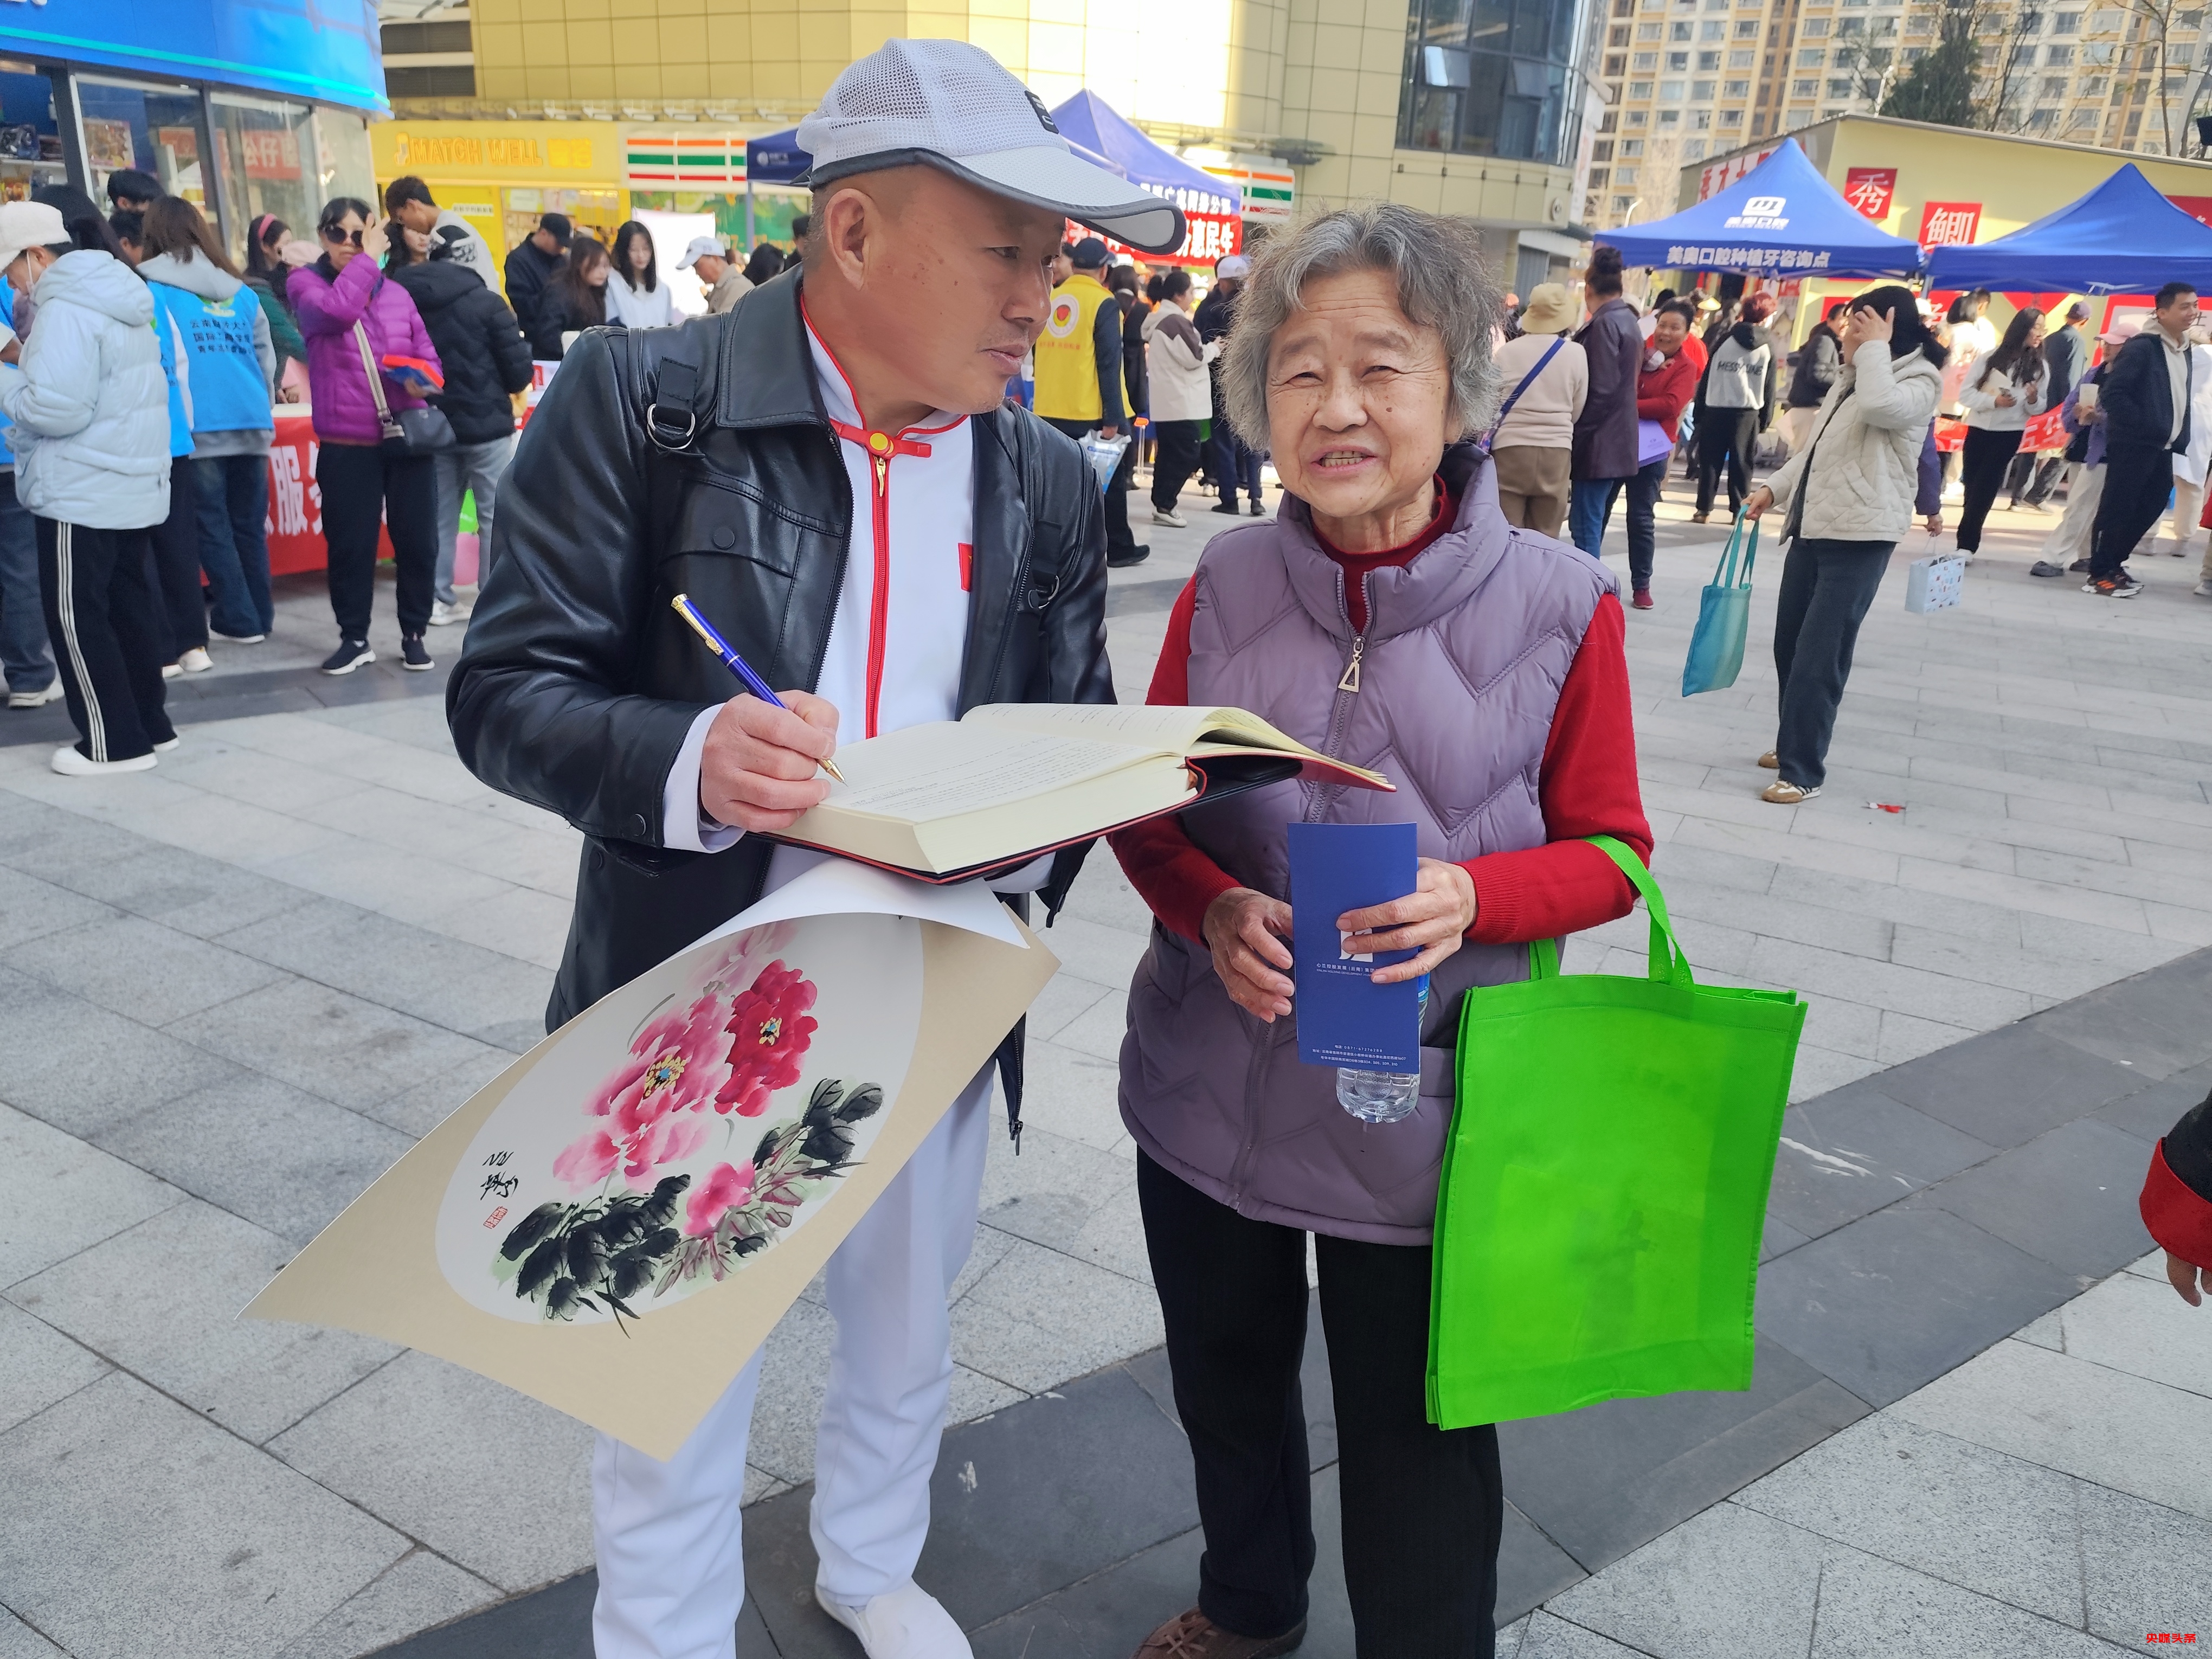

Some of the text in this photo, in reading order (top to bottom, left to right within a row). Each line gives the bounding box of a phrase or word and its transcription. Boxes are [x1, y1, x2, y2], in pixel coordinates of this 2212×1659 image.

[410, 137, 483, 165] MATCH
[486, 139, 543, 166] WELL
[1848, 172, 1888, 215] 秀
